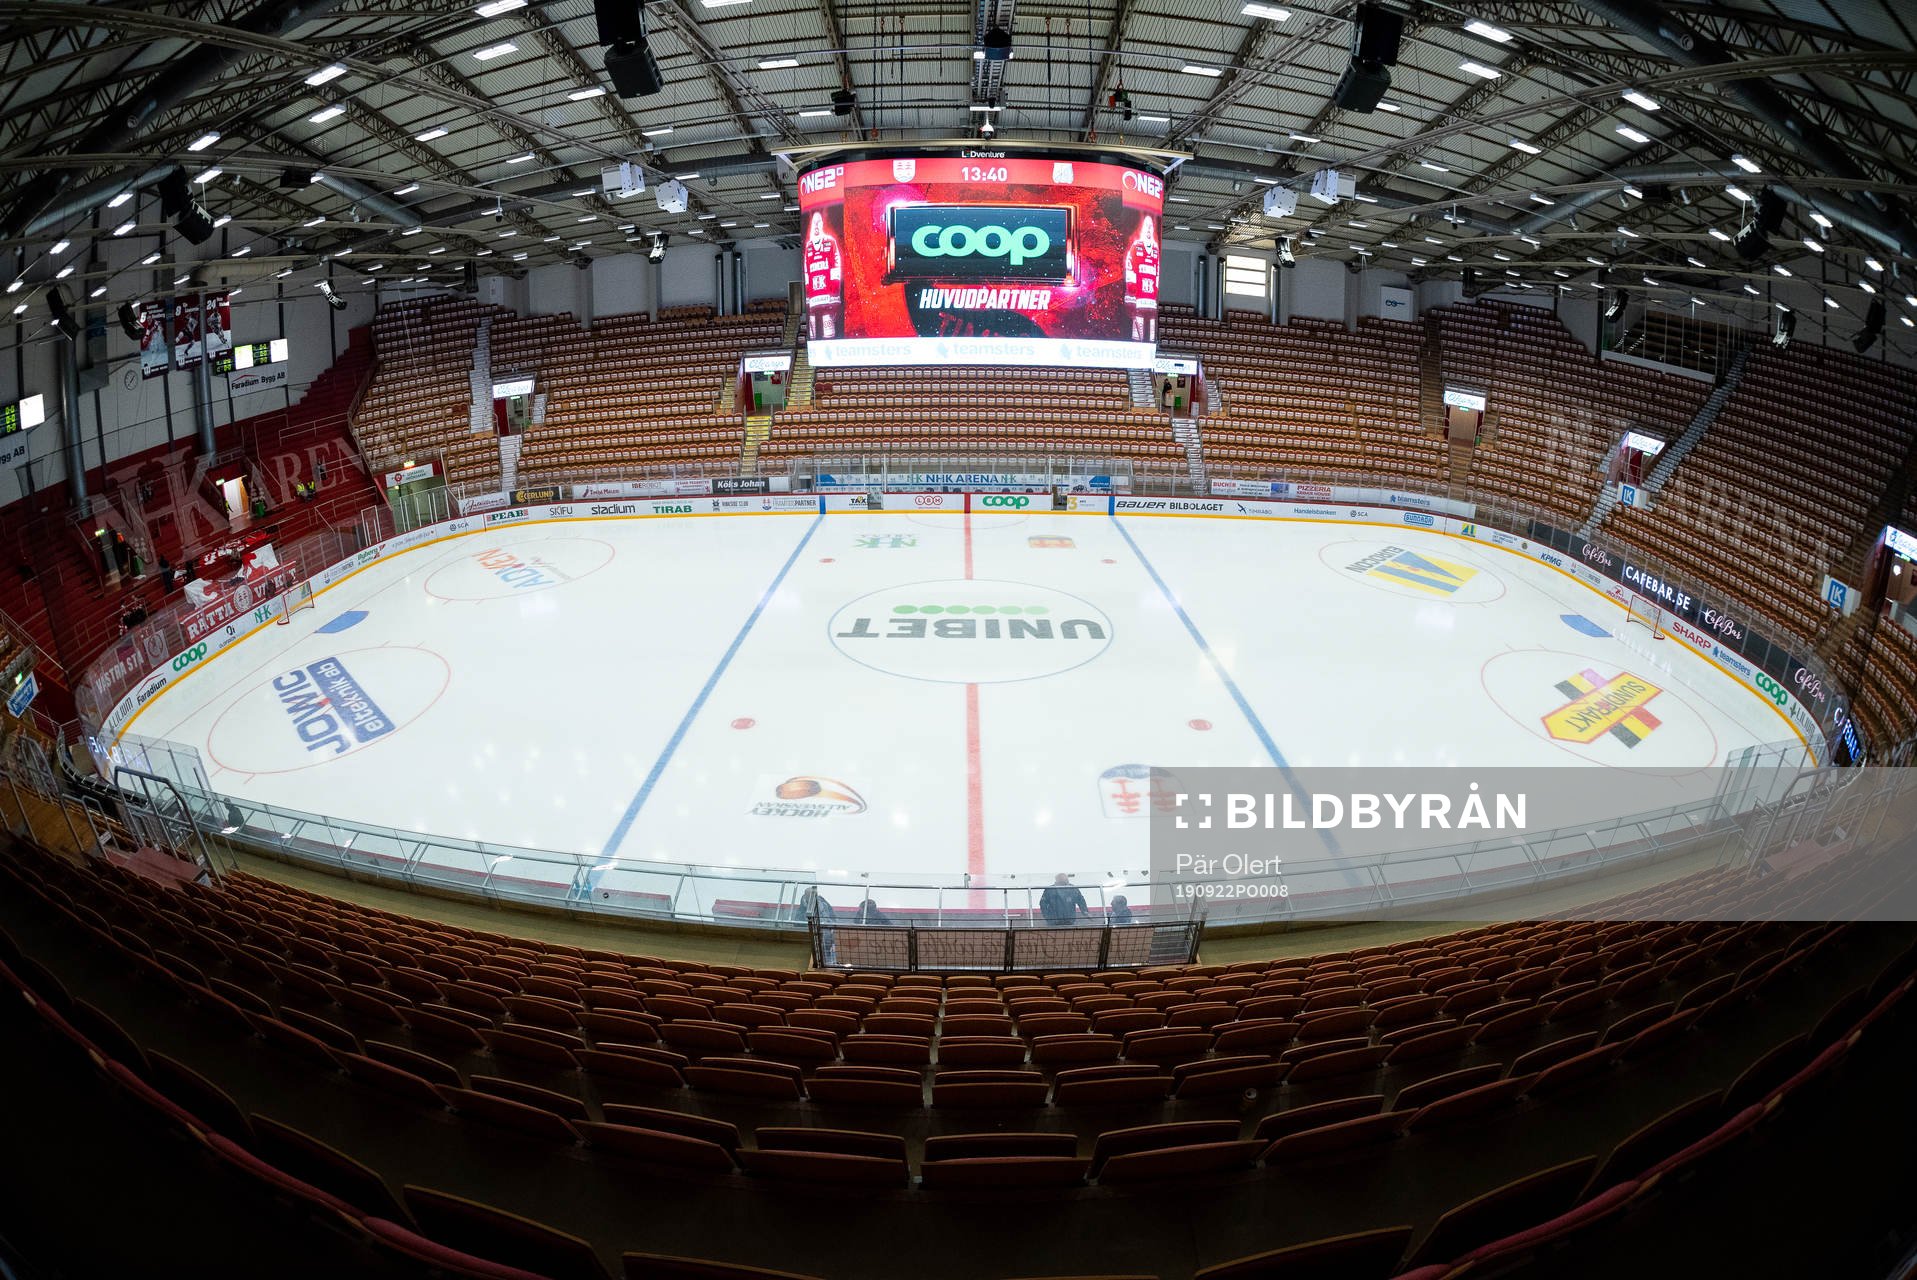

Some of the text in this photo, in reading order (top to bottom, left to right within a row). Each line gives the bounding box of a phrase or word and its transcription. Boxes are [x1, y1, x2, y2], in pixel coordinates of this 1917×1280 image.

[961, 166, 1008, 183] 13:40
[911, 224, 1050, 266] coop
[919, 287, 1051, 310] HUVUDPARTNER
[835, 342, 912, 357] teamsters
[952, 341, 1035, 357] teamsters
[1076, 343, 1143, 360] teamsters
[277, 371, 286, 380] AB
[13, 445, 25, 457] AB
[739, 479, 766, 488] Johan
[926, 474, 952, 483] NHK
[955, 474, 999, 483] ARENA
[591, 503, 636, 515] stadium
[653, 505, 693, 514] TIRAB
[982, 495, 1030, 509] coop
[1116, 501, 1167, 509] BAUER
[1169, 502, 1224, 512] BILBOLAGET
[491, 509, 524, 521] PEAB
[1540, 552, 1562, 567] KPMG
[1625, 565, 1691, 611] CAFEBAR.SE
[836, 617, 1106, 640] UNIBET
[1672, 620, 1711, 650] SHARP
[172, 641, 208, 673] coop
[1719, 649, 1751, 677] teamsters
[136, 677, 167, 706] Faradium
[1755, 672, 1788, 706] coop
[272, 669, 351, 754] JOWIC
